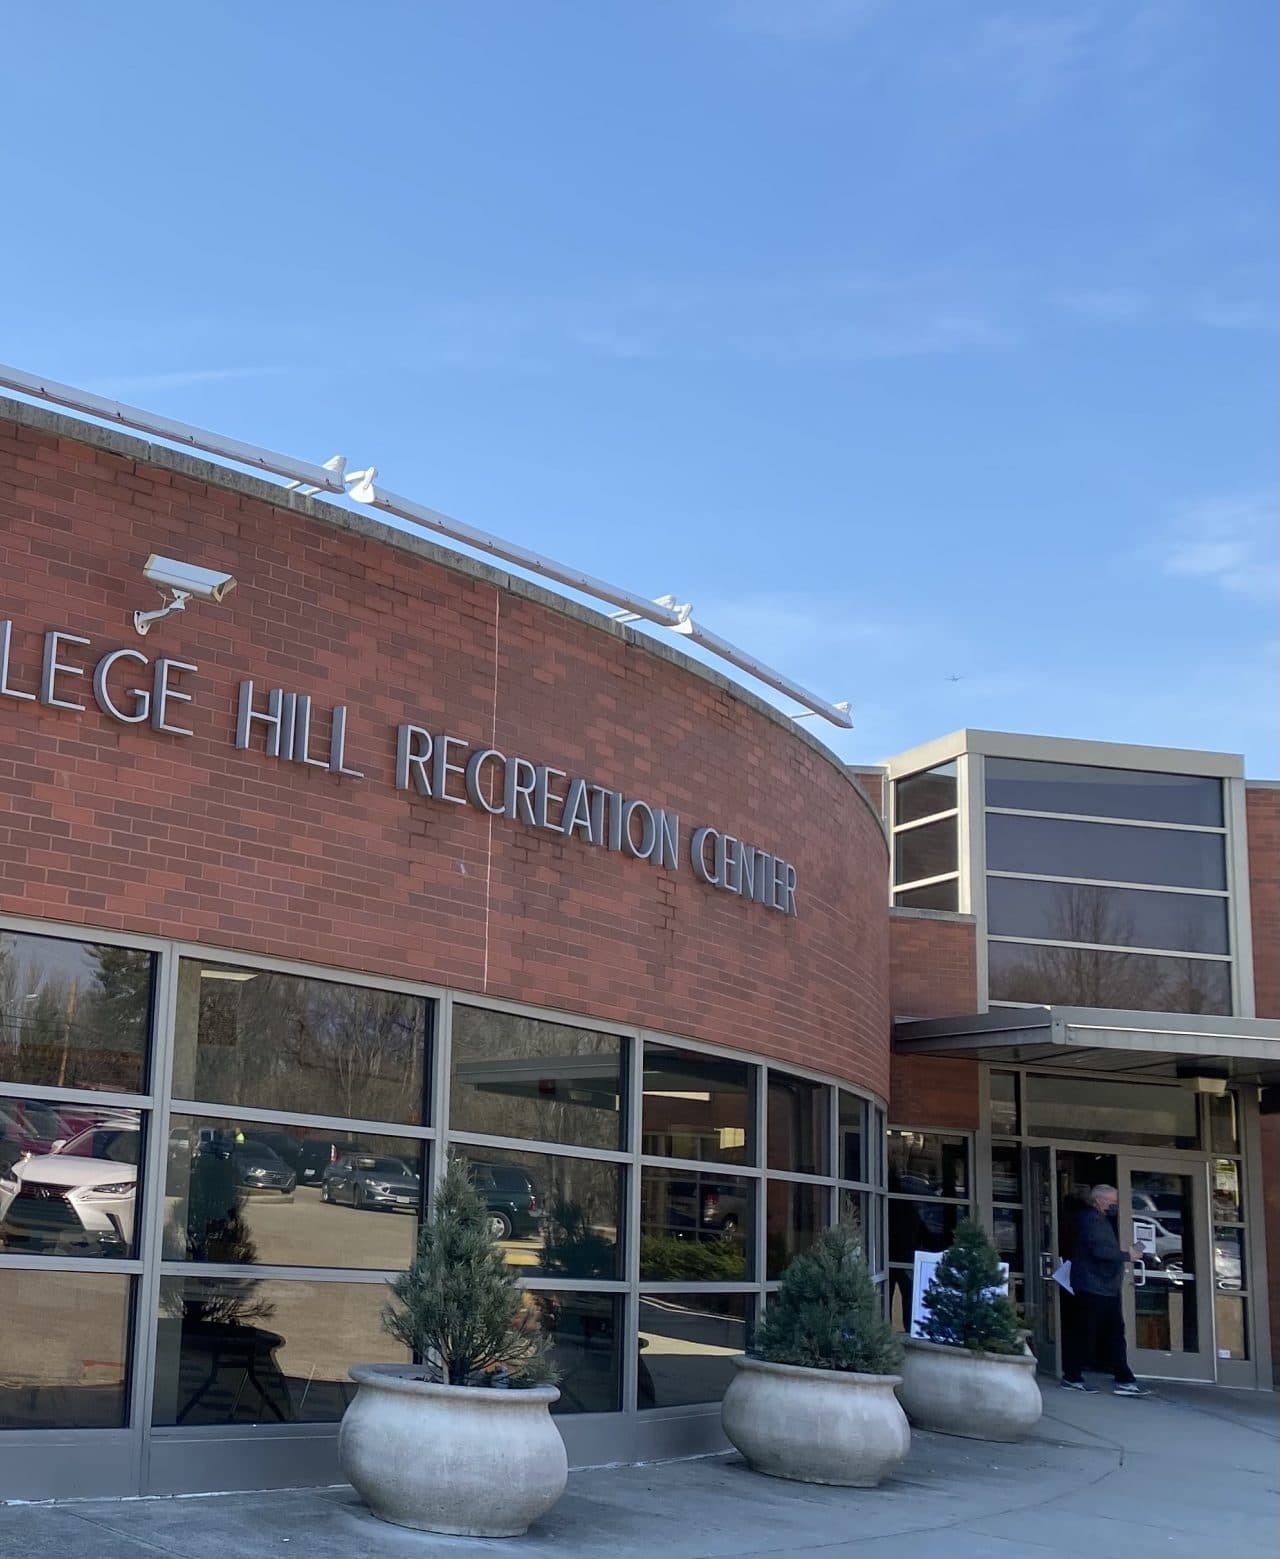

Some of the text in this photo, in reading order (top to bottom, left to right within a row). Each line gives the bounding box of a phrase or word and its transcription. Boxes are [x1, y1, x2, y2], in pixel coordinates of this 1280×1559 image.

[235, 680, 365, 778] HILL
[395, 724, 680, 871] RECREATION
[690, 827, 798, 917] CENTER
